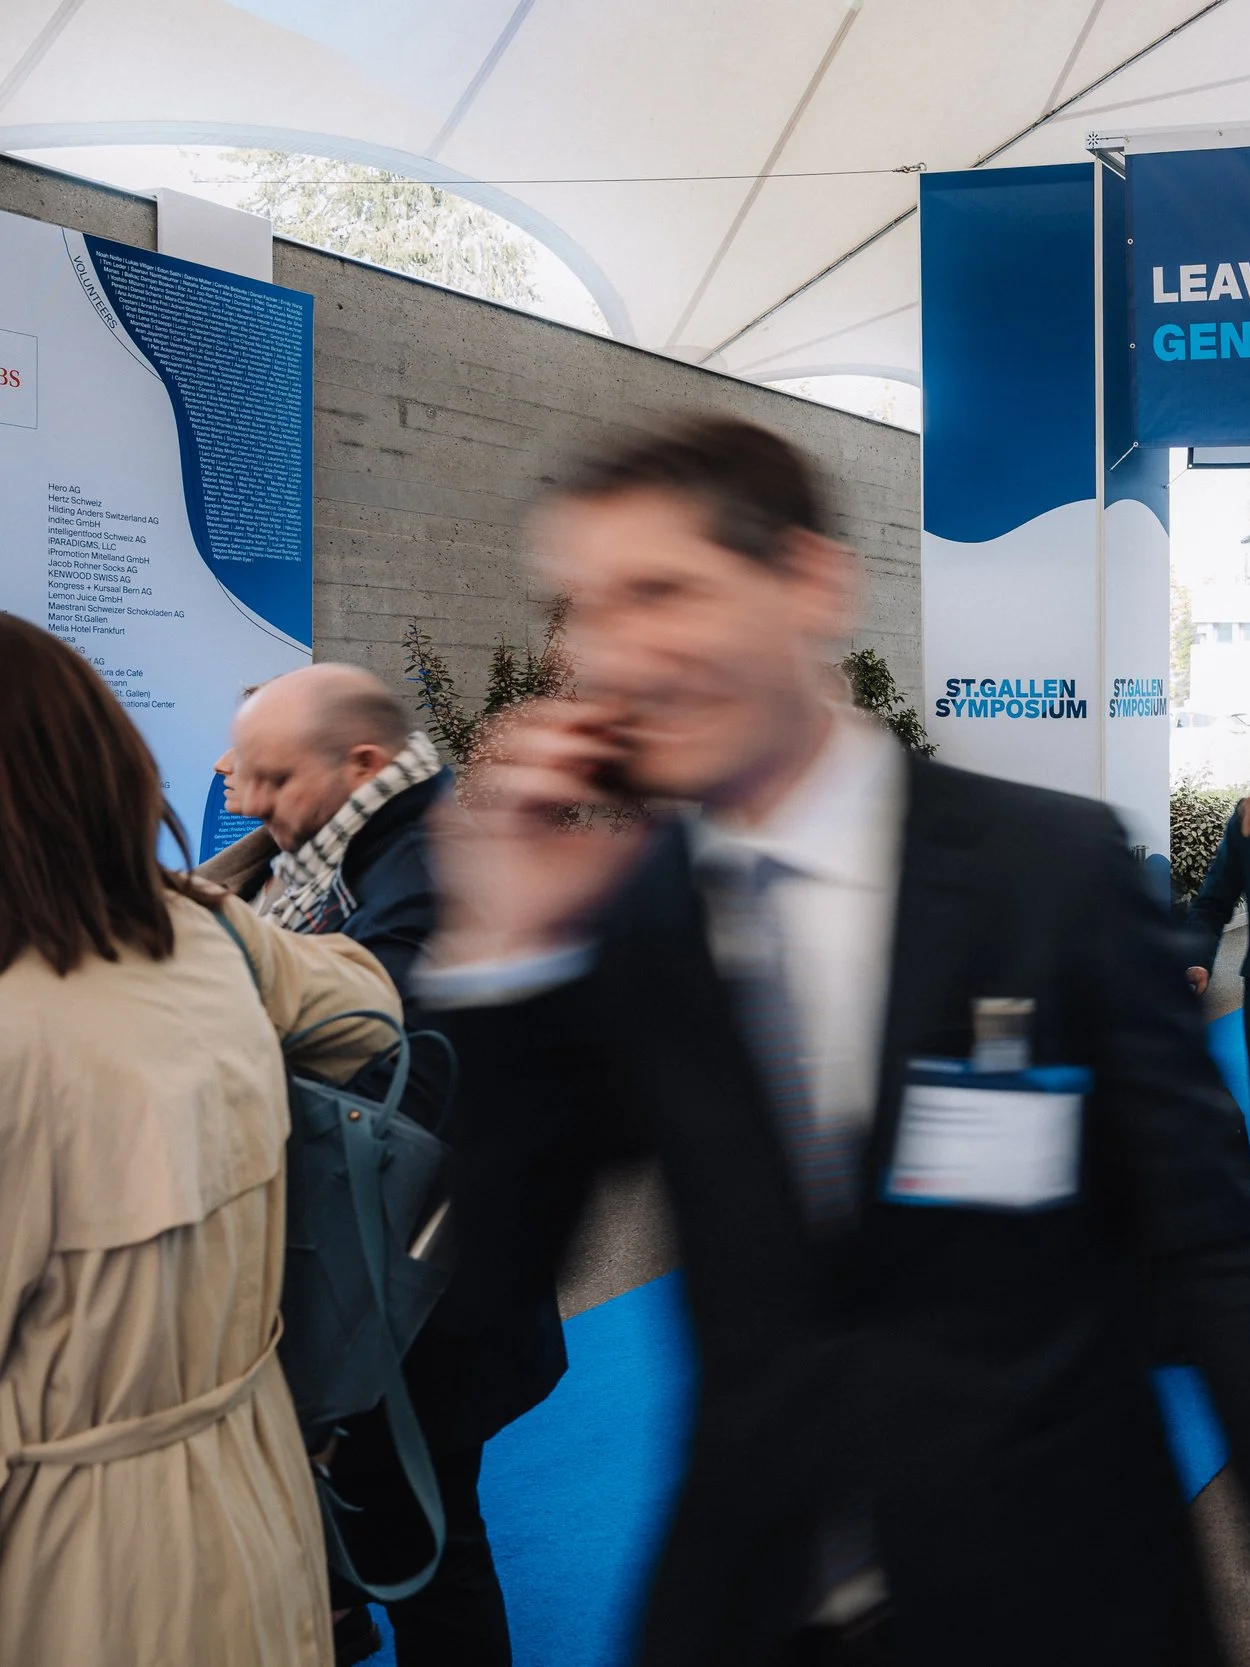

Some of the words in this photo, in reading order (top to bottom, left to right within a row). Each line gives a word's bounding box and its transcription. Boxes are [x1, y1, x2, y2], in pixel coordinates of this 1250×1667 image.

[74, 256, 118, 329] VOLUNTEERS
[48, 483, 67, 492] Hero
[69, 485, 80, 494] AG
[48, 494, 69, 503] Hertz
[71, 497, 102, 507] Schweiz
[48, 505, 75, 516] Hilding
[77, 508, 103, 518] Anders
[105, 512, 147, 523] Switzerland
[76, 519, 100, 528] GmbH
[48, 527, 102, 539] intelligentfood
[104, 532, 133, 542] Schweiz
[135, 535, 146, 543] AG
[48, 548, 90, 558] iPromotion
[126, 555, 149, 564] GmbH
[48, 559, 72, 567] Jacob
[74, 561, 101, 570] Rohner
[103, 564, 125, 572] Socks
[48, 570, 91, 580] KENWOOD
[93, 574, 118, 582] SWISS
[48, 581, 84, 590] Kongress
[94, 584, 121, 593] Kursaal
[123, 586, 139, 594] Bern
[48, 592, 75, 600] Lemon
[76, 594, 97, 602] Juice
[99, 595, 122, 603] GmbH
[48, 602, 86, 611] Maestrani
[88, 605, 125, 614] Schweizer
[127, 607, 172, 617] Schokoladen
[174, 610, 184, 618] AG
[48, 613, 73, 621] Manor
[71, 624, 91, 633] Hotel
[92, 626, 125, 634] Frankfurt
[126, 669, 143, 677] Café
[126, 690, 151, 698] Gallen)
[946, 678, 1075, 698] ST.GALLEN
[1113, 678, 1163, 697] ST.GALLEN
[151, 701, 175, 709] Center
[936, 699, 1087, 718] SYMPOSIUM
[1109, 698, 1167, 718] SYMPOSIUM
